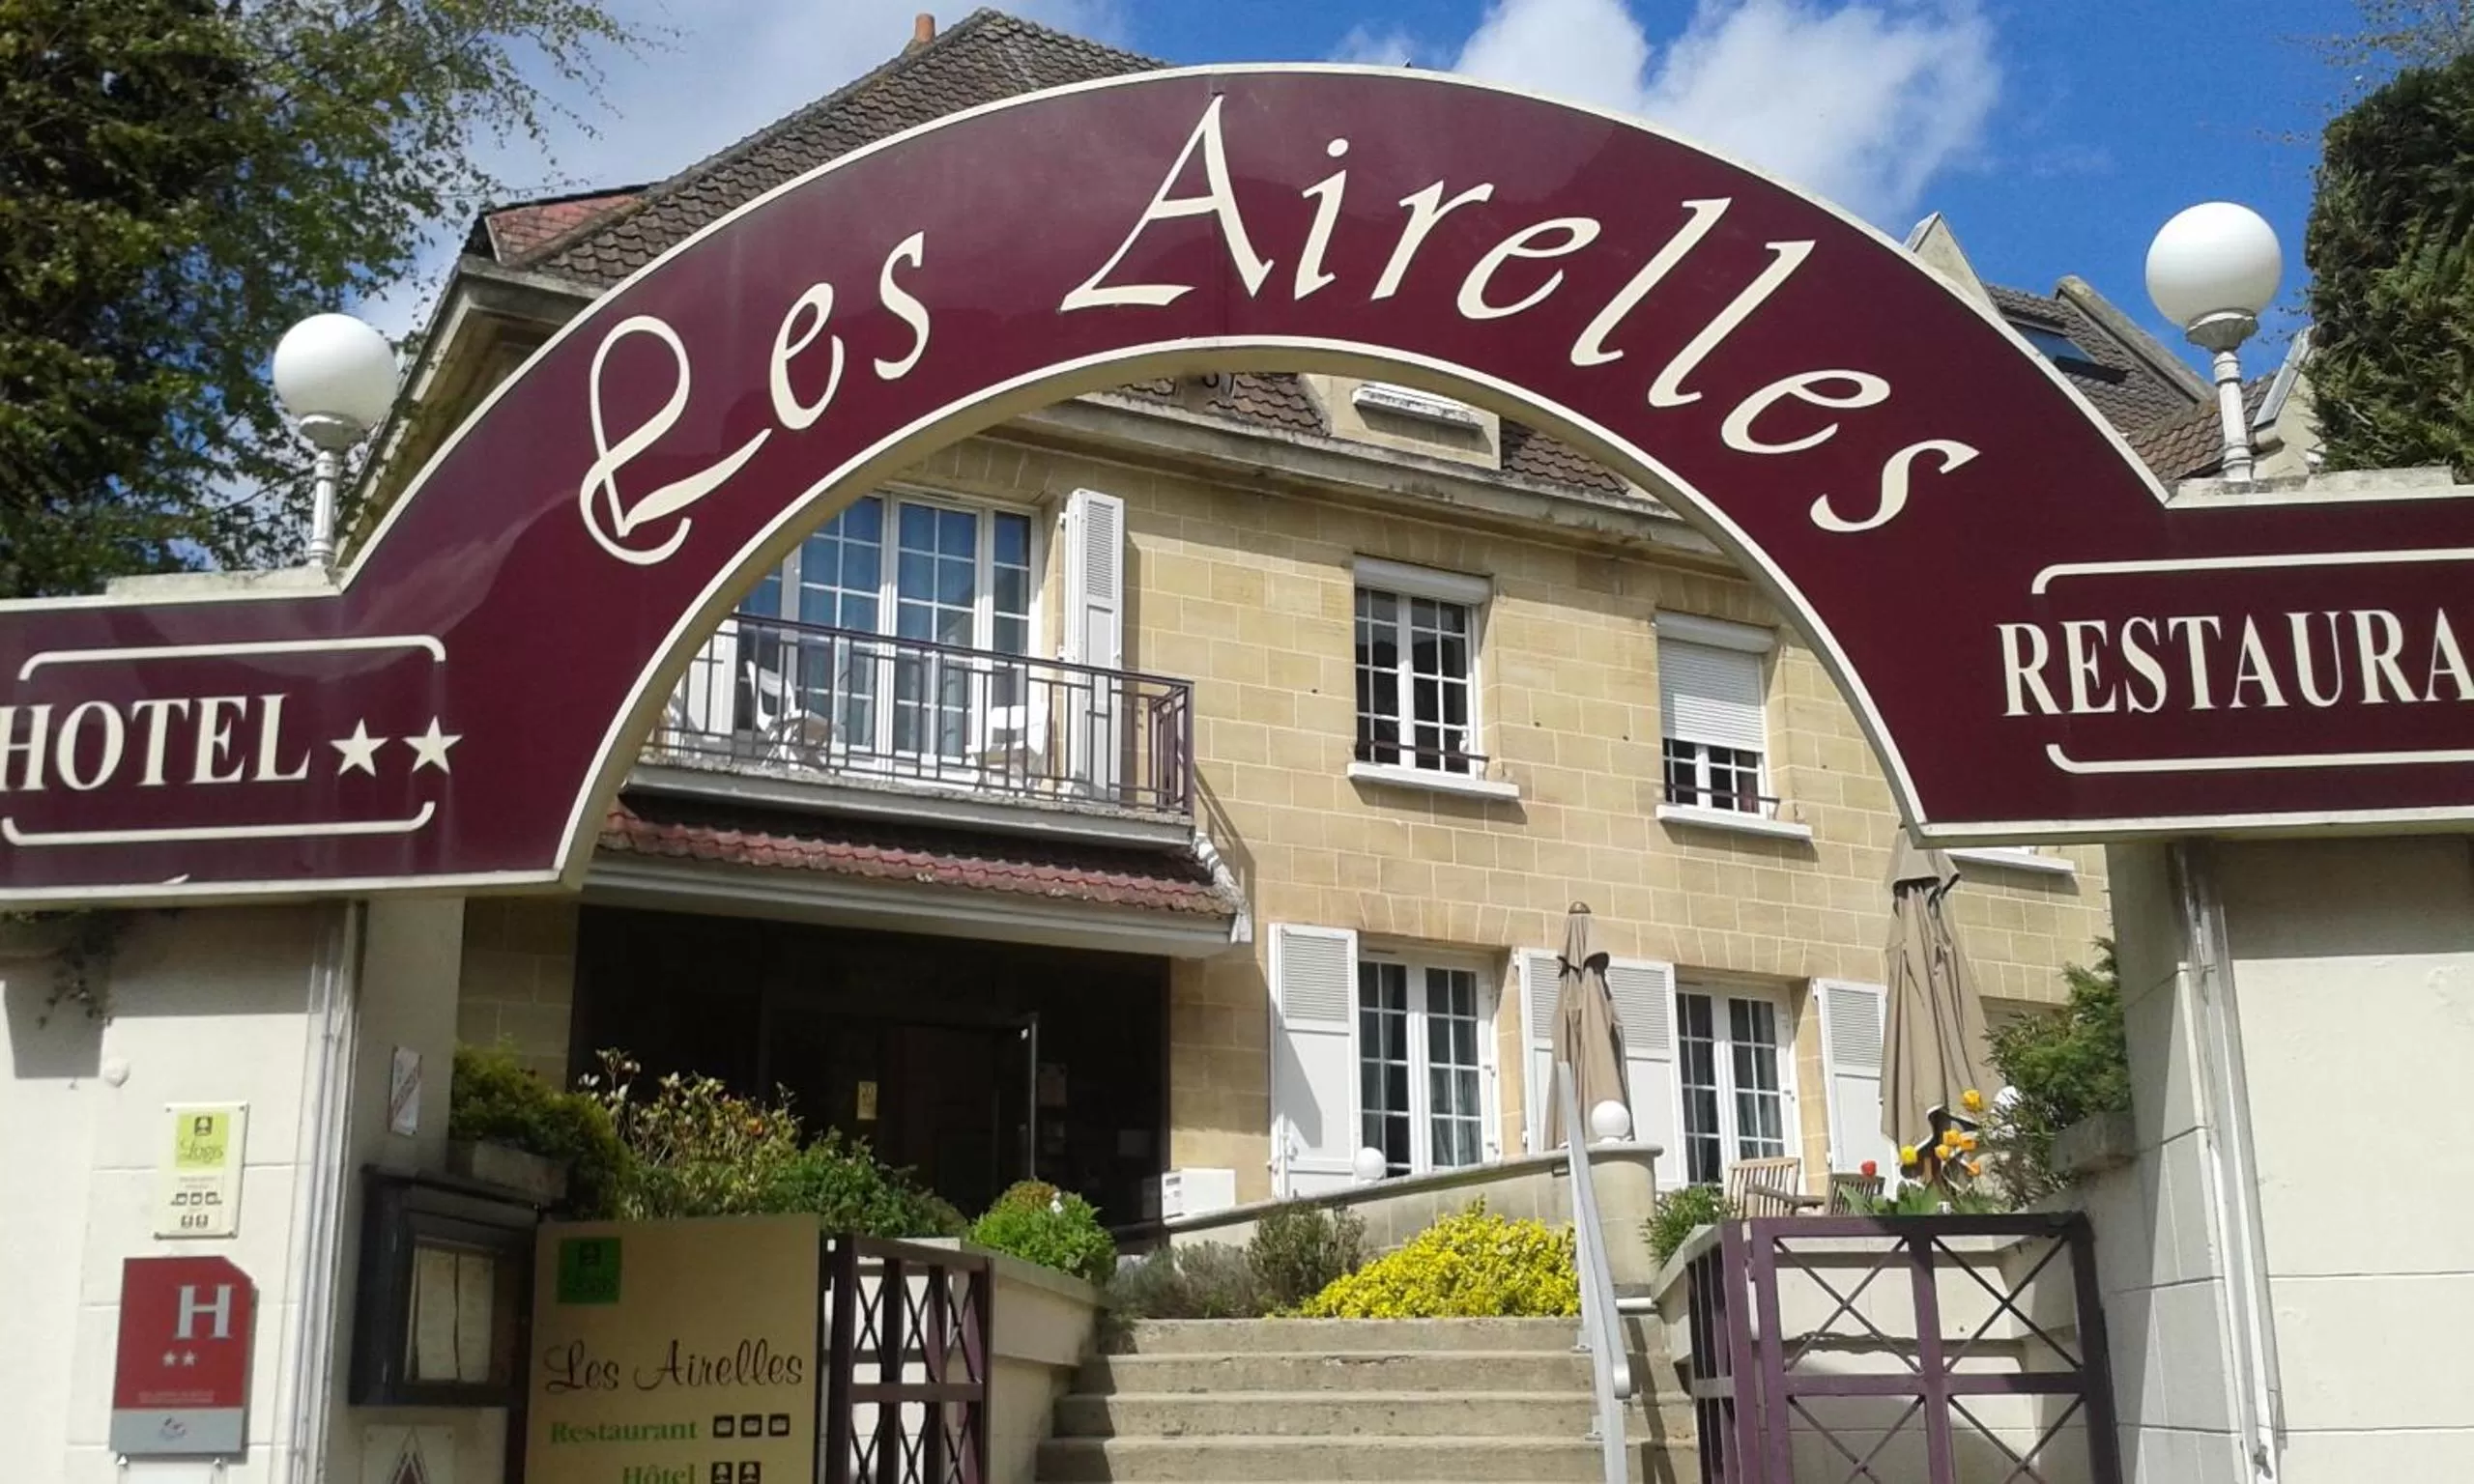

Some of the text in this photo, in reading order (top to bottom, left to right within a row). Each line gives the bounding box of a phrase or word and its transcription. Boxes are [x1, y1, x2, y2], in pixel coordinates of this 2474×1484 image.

[579, 94, 1981, 566] Les Airelles
[1996, 608, 2474, 717] RESTAURA
[0, 693, 311, 791] HOTEL
[175, 1285, 234, 1339] H
[543, 1338, 804, 1392] Les Airelles
[550, 1420, 699, 1444] Restaurant
[622, 1464, 696, 1484] Hôtel
